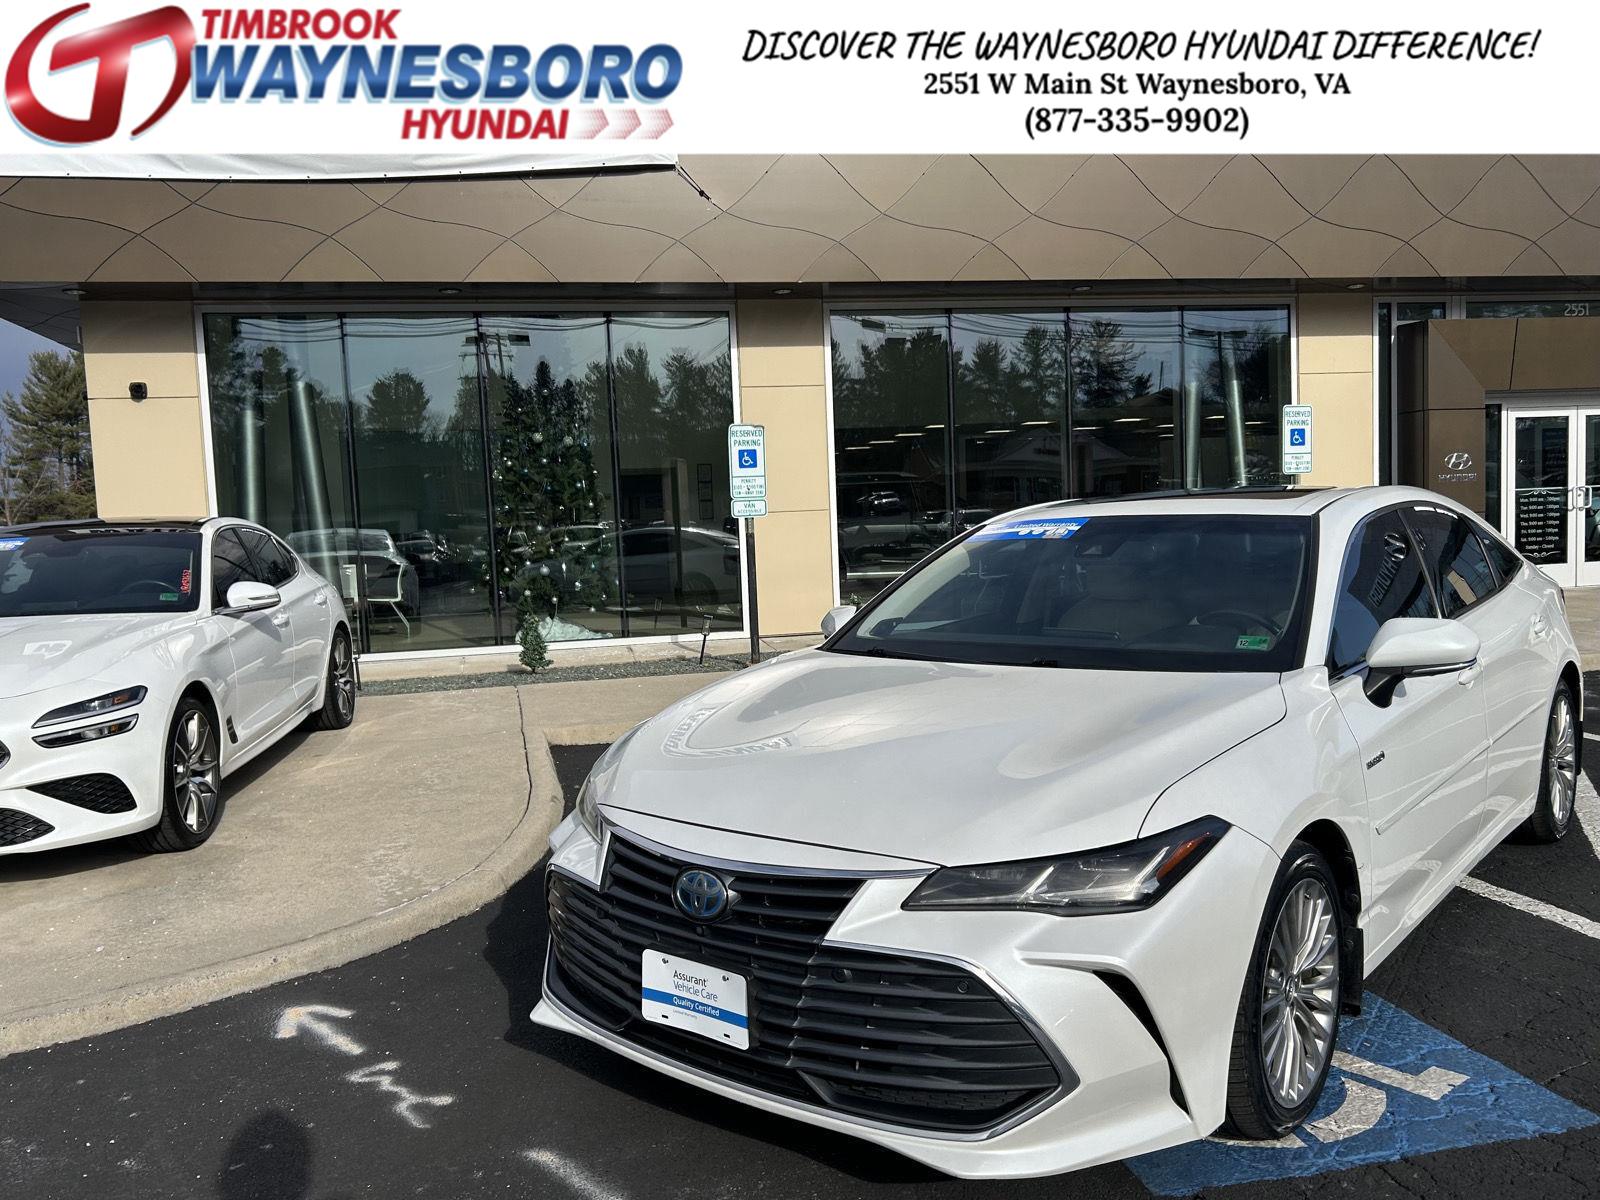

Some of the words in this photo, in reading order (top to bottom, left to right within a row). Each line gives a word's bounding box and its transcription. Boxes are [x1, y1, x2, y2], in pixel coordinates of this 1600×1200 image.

[1564, 303, 1589, 317] 2551
[1285, 410, 1311, 418] RESERVED
[1286, 419, 1310, 427] PARKING
[731, 429, 763, 438] RESERVED
[733, 439, 761, 447] PARKING
[672, 969, 707, 988] Assurant
[672, 980, 700, 997] Vehicle
[700, 988, 719, 1003] Care
[672, 996, 695, 1010] Quality
[694, 1001, 720, 1017] Certified
